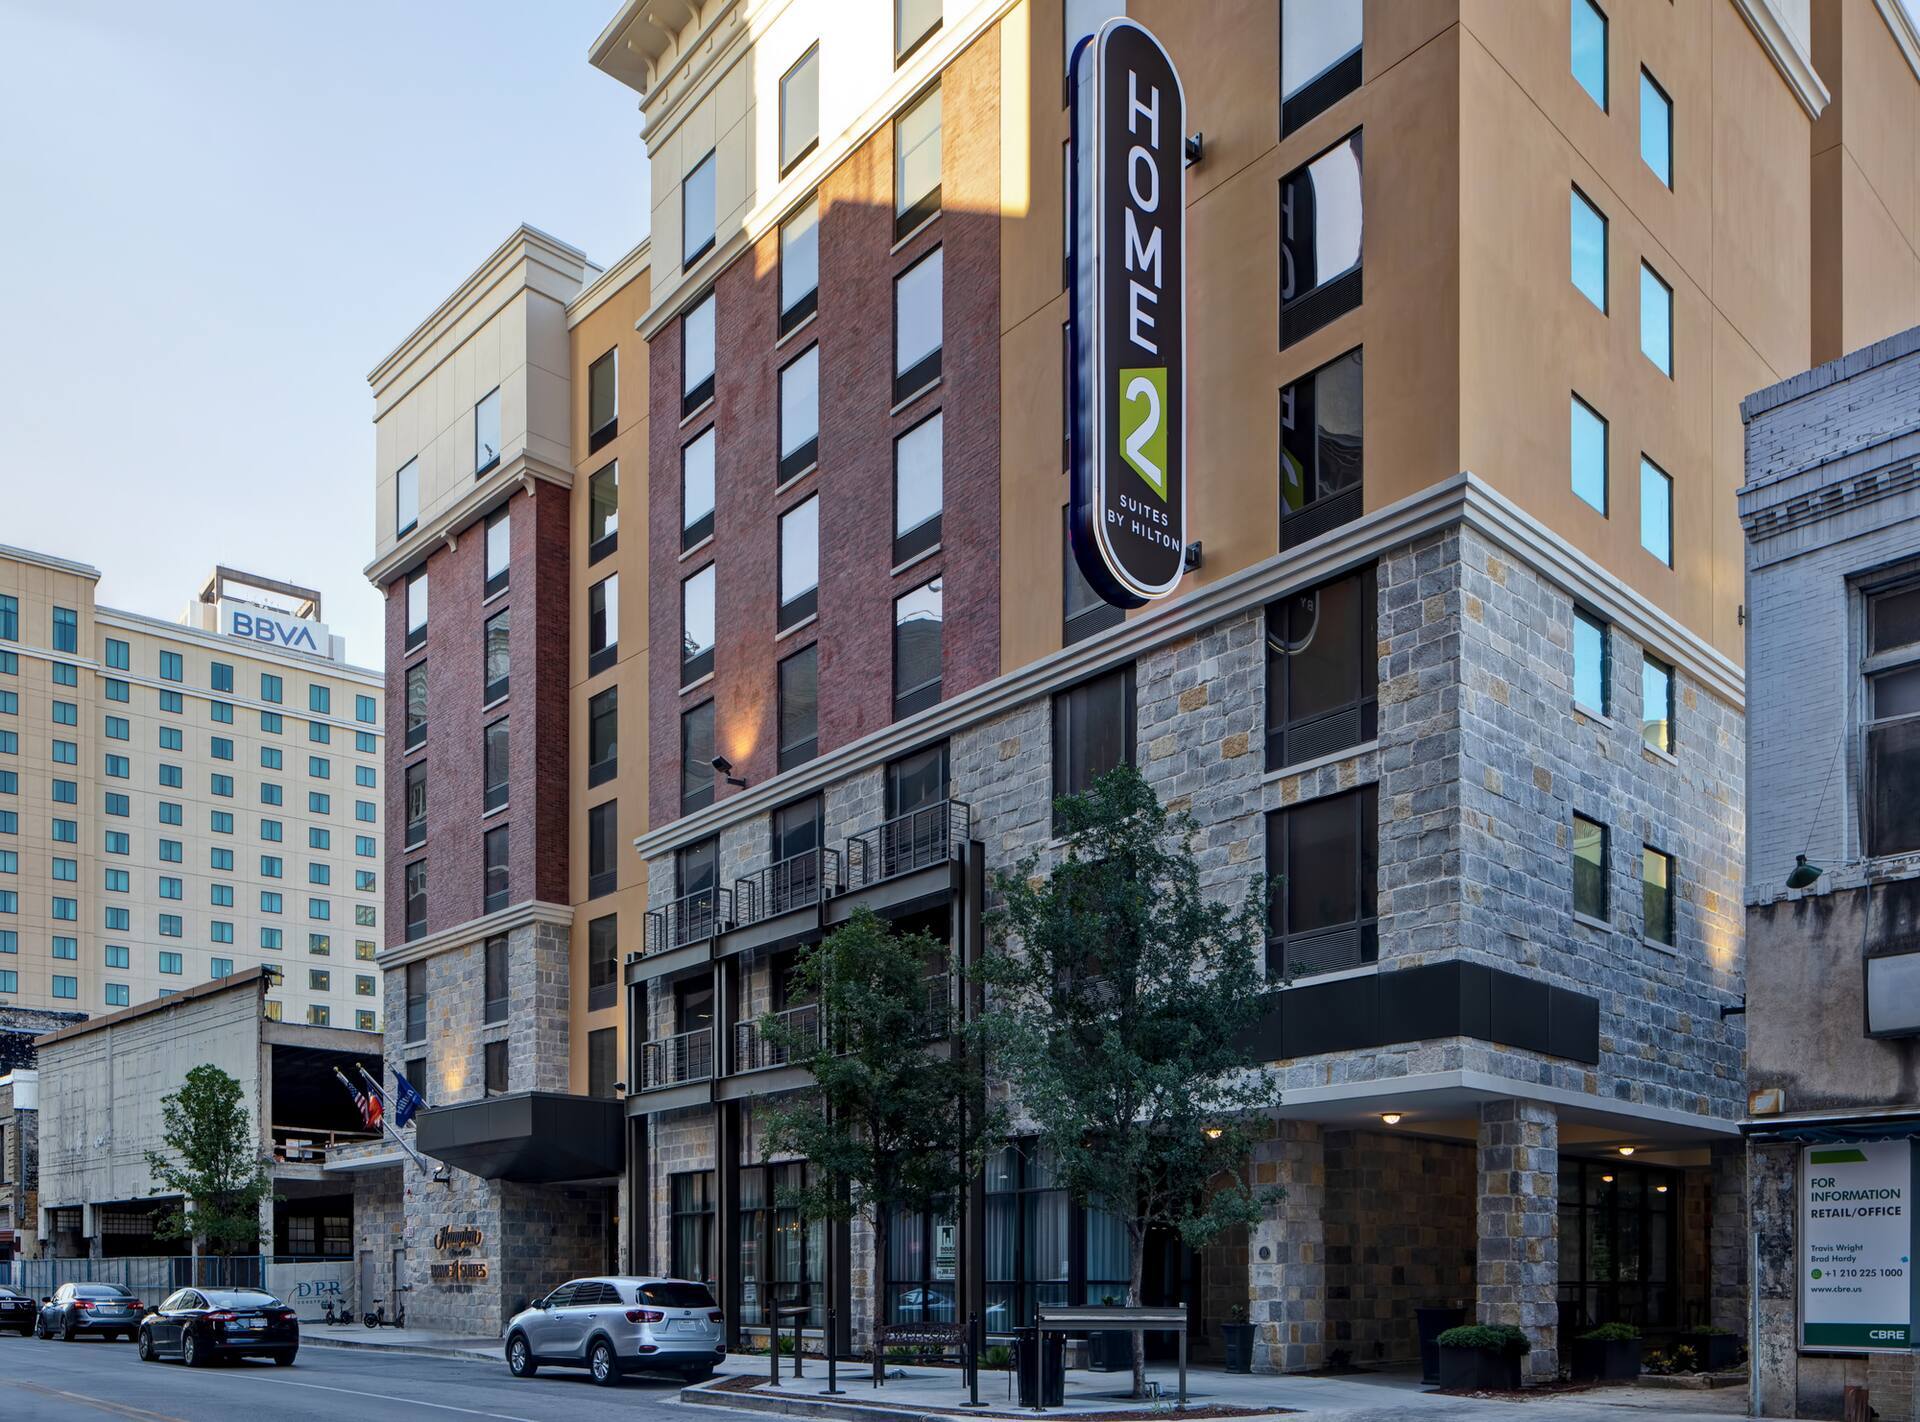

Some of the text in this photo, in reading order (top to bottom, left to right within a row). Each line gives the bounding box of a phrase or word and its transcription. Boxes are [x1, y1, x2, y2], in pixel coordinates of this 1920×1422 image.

[1125, 68, 1162, 355] HOME
[1125, 376, 1162, 488] 2
[1119, 494, 1169, 527] SUITES
[1107, 509, 1180, 552] BY HILTON
[233, 611, 317, 651] BBVA
[1811, 1177, 1836, 1189] FOR
[1811, 1188, 1901, 1203] INFORMATION
[1810, 1206, 1902, 1219] RETAIL/OFFICE
[1811, 1244, 1864, 1253] Travis Wright
[1811, 1254, 1857, 1264] Brad Hardy
[1825, 1268, 1903, 1278] +1 210 225 1000
[296, 1281, 343, 1297] DPR
[1810, 1285, 1863, 1293] www.cbre.us
[1869, 1329, 1905, 1340] CBRE
